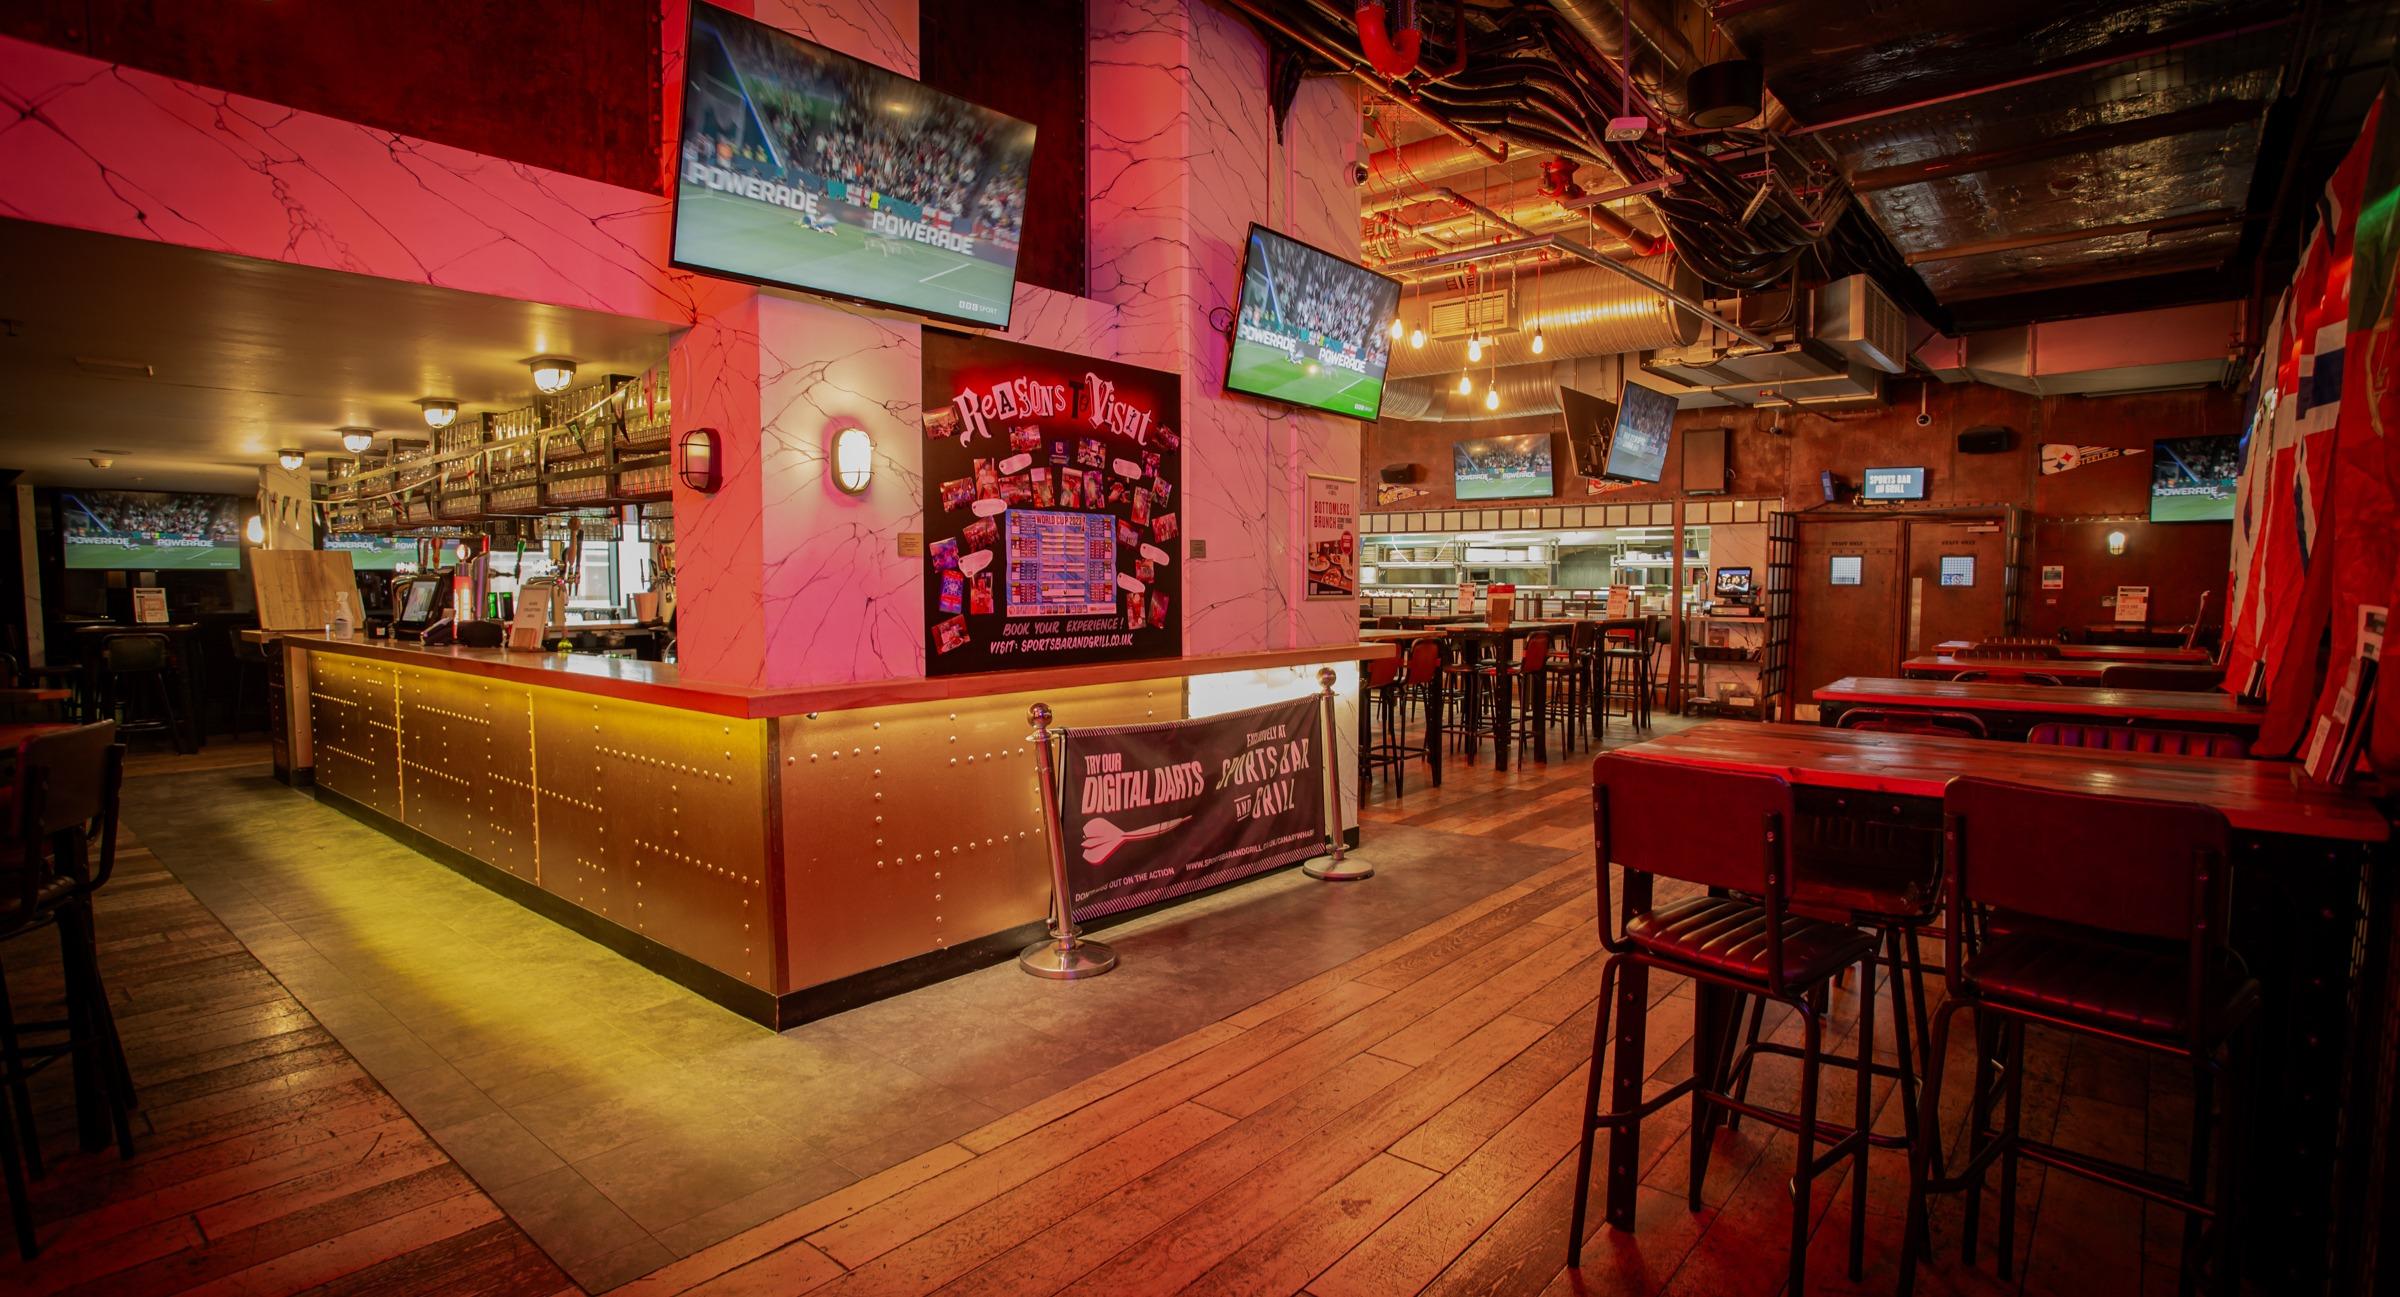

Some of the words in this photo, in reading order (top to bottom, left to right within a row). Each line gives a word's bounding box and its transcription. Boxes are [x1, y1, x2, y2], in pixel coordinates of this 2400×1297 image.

[687, 162, 819, 214] POWERADE
[873, 211, 975, 256] POWERADE
[979, 305, 997, 315] SPORT
[1239, 323, 1297, 352] POWERADE
[1319, 348, 1367, 373] POWERADE
[2076, 449, 2120, 466] STEELERS
[1870, 474, 1896, 484] SPORTS
[1897, 474, 1911, 484] BAR
[2155, 486, 2218, 497] POWERADE
[1314, 500, 1350, 516] BOTTOMLESS
[1036, 516, 1056, 525] WORLD
[1314, 515, 1337, 529] BRUNCH
[67, 536, 130, 546] POWERADE
[158, 538, 215, 548] POWERADE
[325, 541, 374, 550] POWERADE
[1003, 622, 1030, 636] BOOK
[1034, 621, 1060, 634] YOUR
[990, 640, 1019, 654] VISIT:
[1021, 633, 1134, 652] SPORTSBARANDGRILL.CO.UK
[1278, 724, 1287, 739] AT
[1084, 754, 1101, 775] TRY
[1102, 752, 1122, 773] OUR
[1215, 746, 1278, 790] SPORTS
[1279, 738, 1310, 775] BAR
[1081, 769, 1151, 814] DIGITAL
[1154, 760, 1205, 804] DARTS
[1236, 798, 1252, 818] AND
[1252, 779, 1295, 819] GRILL
[1109, 877, 1123, 889] OUT
[1123, 875, 1134, 886] ON
[1134, 872, 1149, 882] THE
[1148, 866, 1175, 880] ACTION
